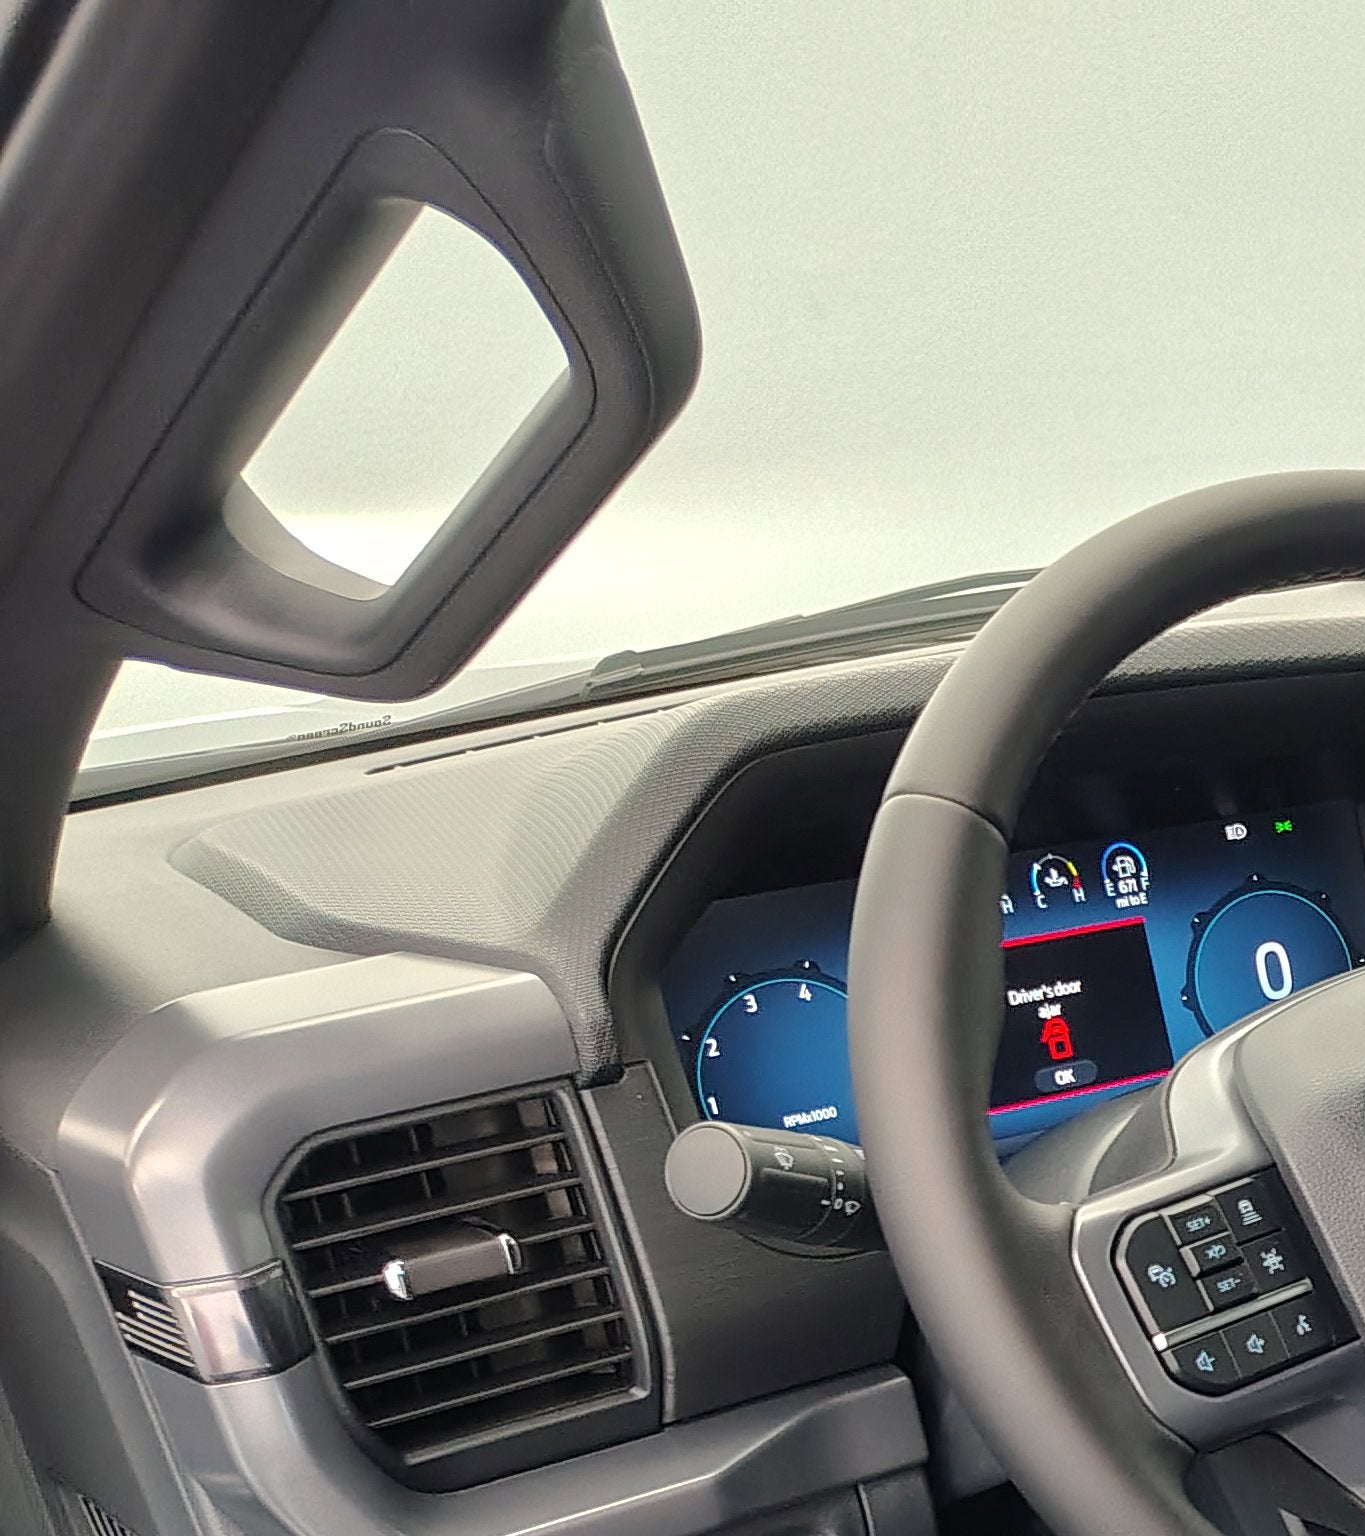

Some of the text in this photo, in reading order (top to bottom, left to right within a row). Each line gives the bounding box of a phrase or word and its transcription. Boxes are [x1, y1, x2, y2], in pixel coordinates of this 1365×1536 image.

[1253, 941, 1296, 1001] 0
[799, 983, 812, 1001] 4
[1007, 980, 1082, 1006] Driver's door
[742, 994, 758, 1013] 3
[1037, 1003, 1062, 1019] ajar
[704, 1038, 721, 1057] 2
[1054, 1068, 1076, 1086] OK
[707, 1096, 719, 1115] 1
